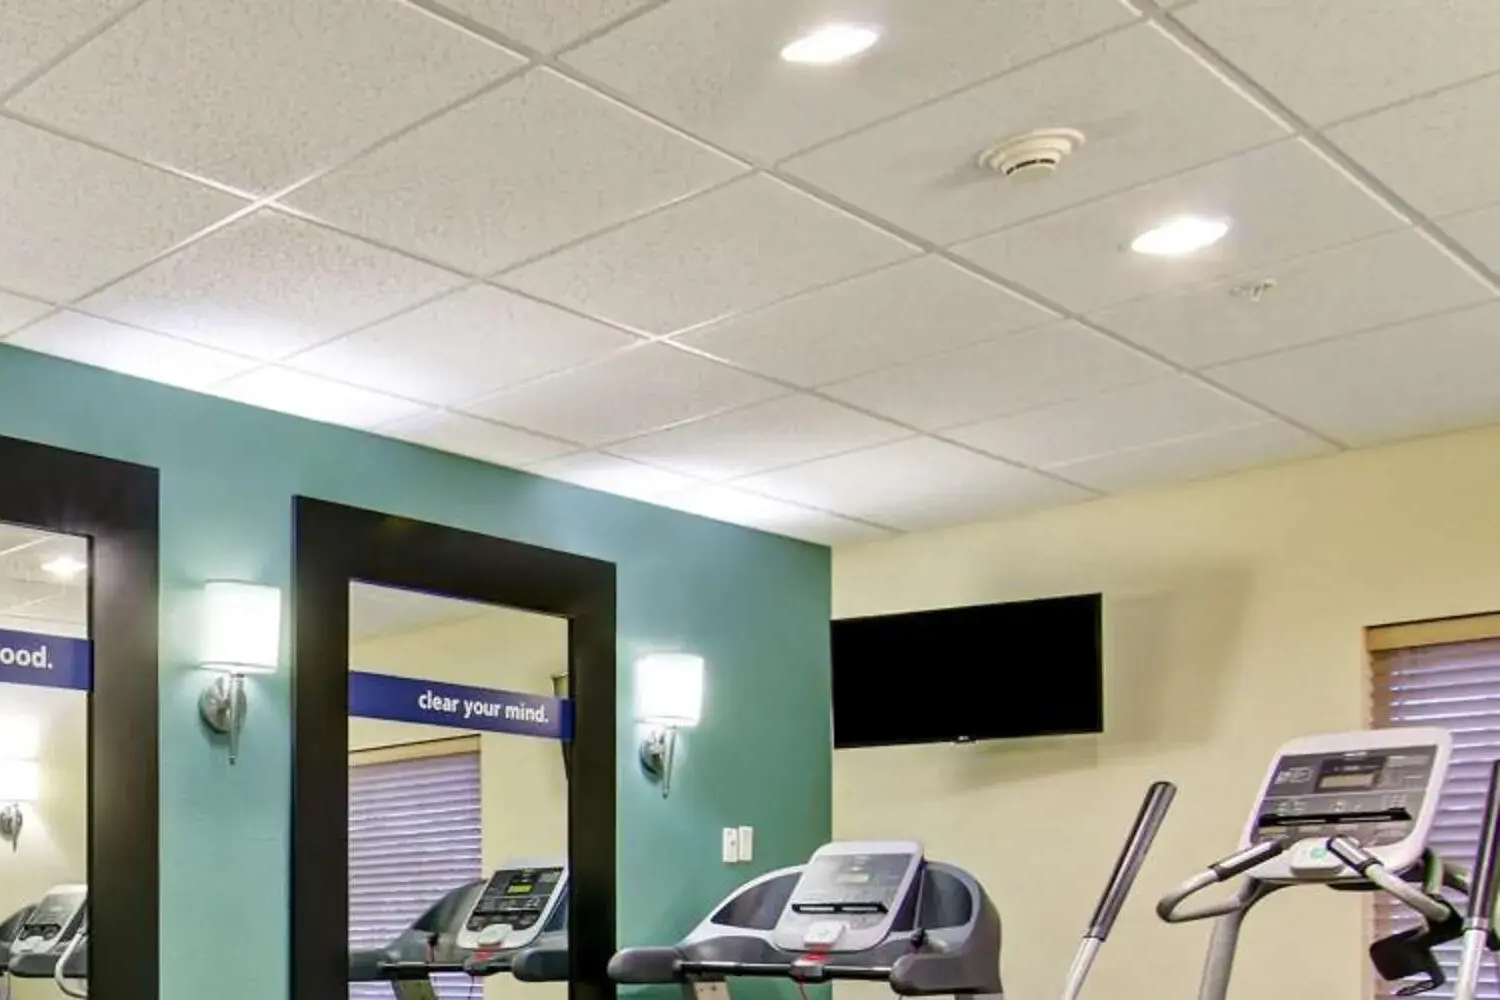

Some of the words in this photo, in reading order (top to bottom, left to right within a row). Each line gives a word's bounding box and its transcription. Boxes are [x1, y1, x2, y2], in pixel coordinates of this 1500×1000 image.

[417, 689, 460, 713] clear
[463, 699, 502, 720] your
[504, 703, 550, 724] mind.
